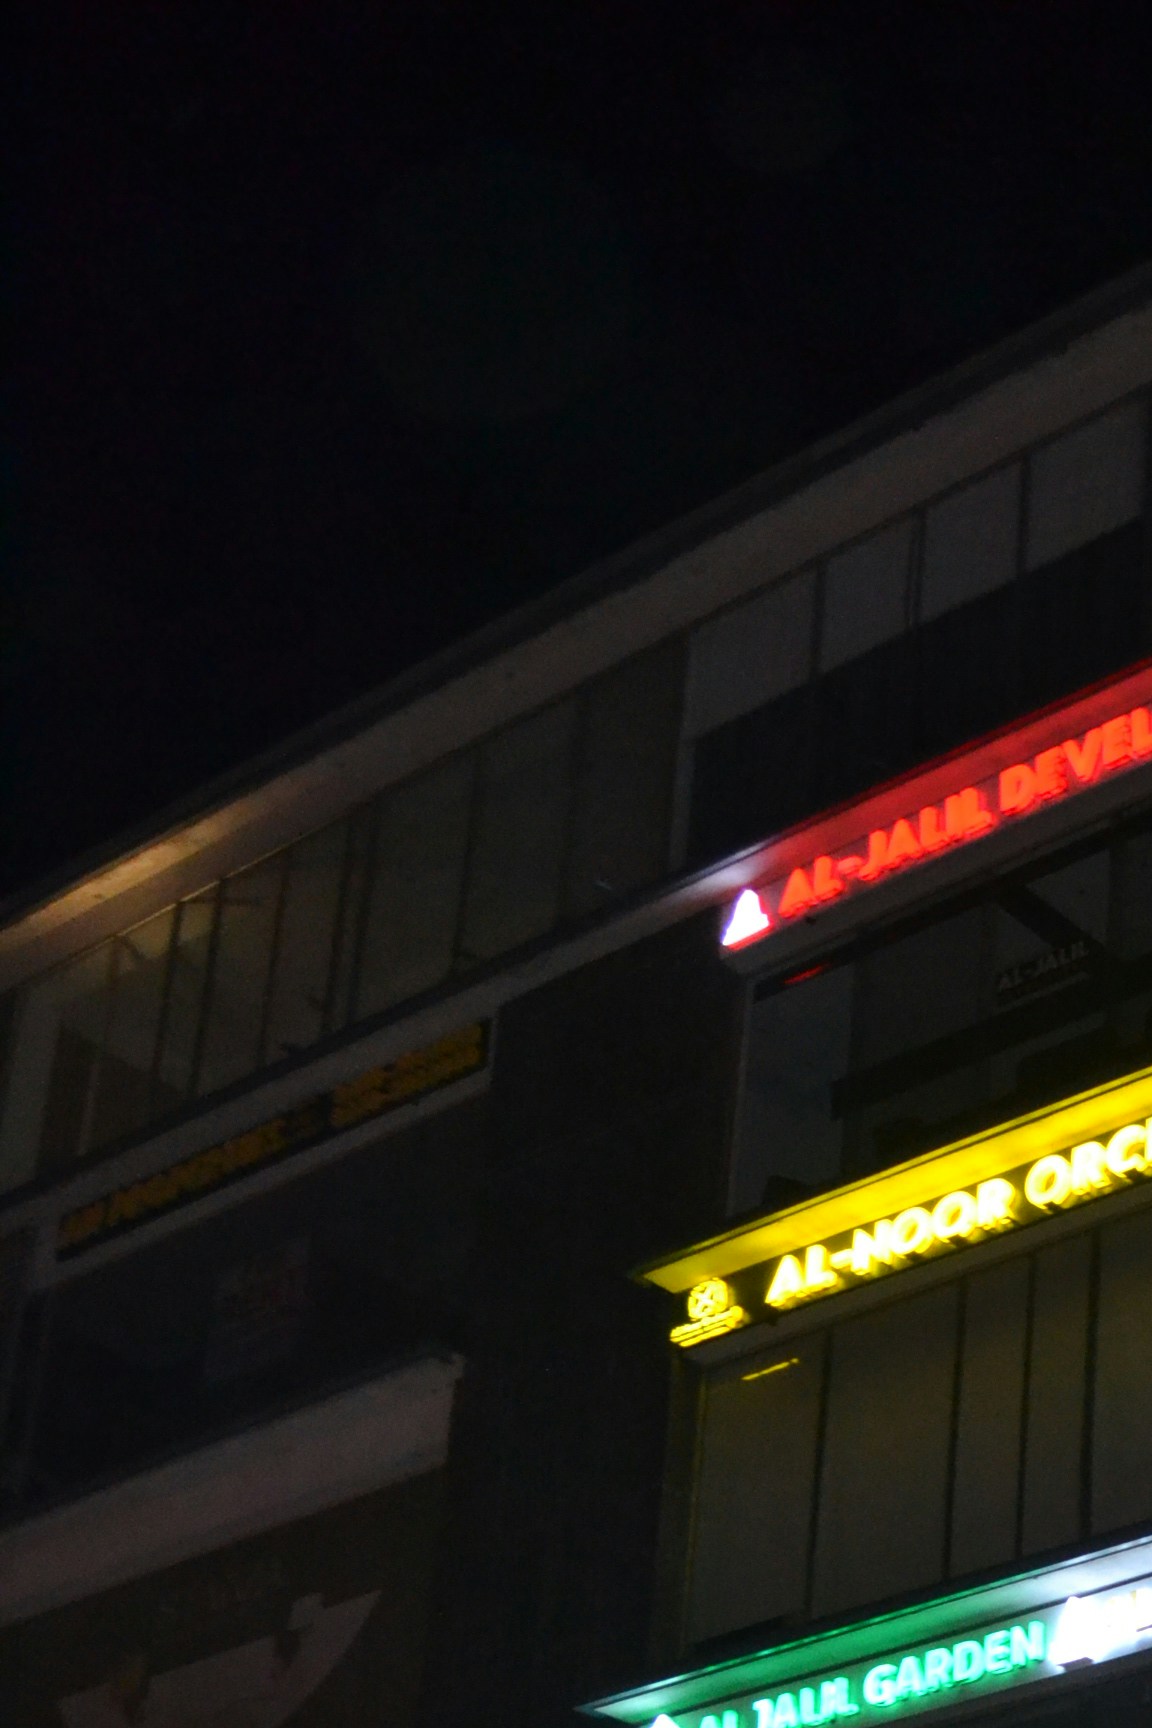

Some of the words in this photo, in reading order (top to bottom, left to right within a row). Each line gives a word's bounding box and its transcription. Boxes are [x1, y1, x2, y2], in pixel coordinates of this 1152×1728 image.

[778, 786, 992, 919] AL-JALIL
[764, 1176, 1020, 1310] AL-NOOR
[862, 1620, 1046, 1708] GARDEN
